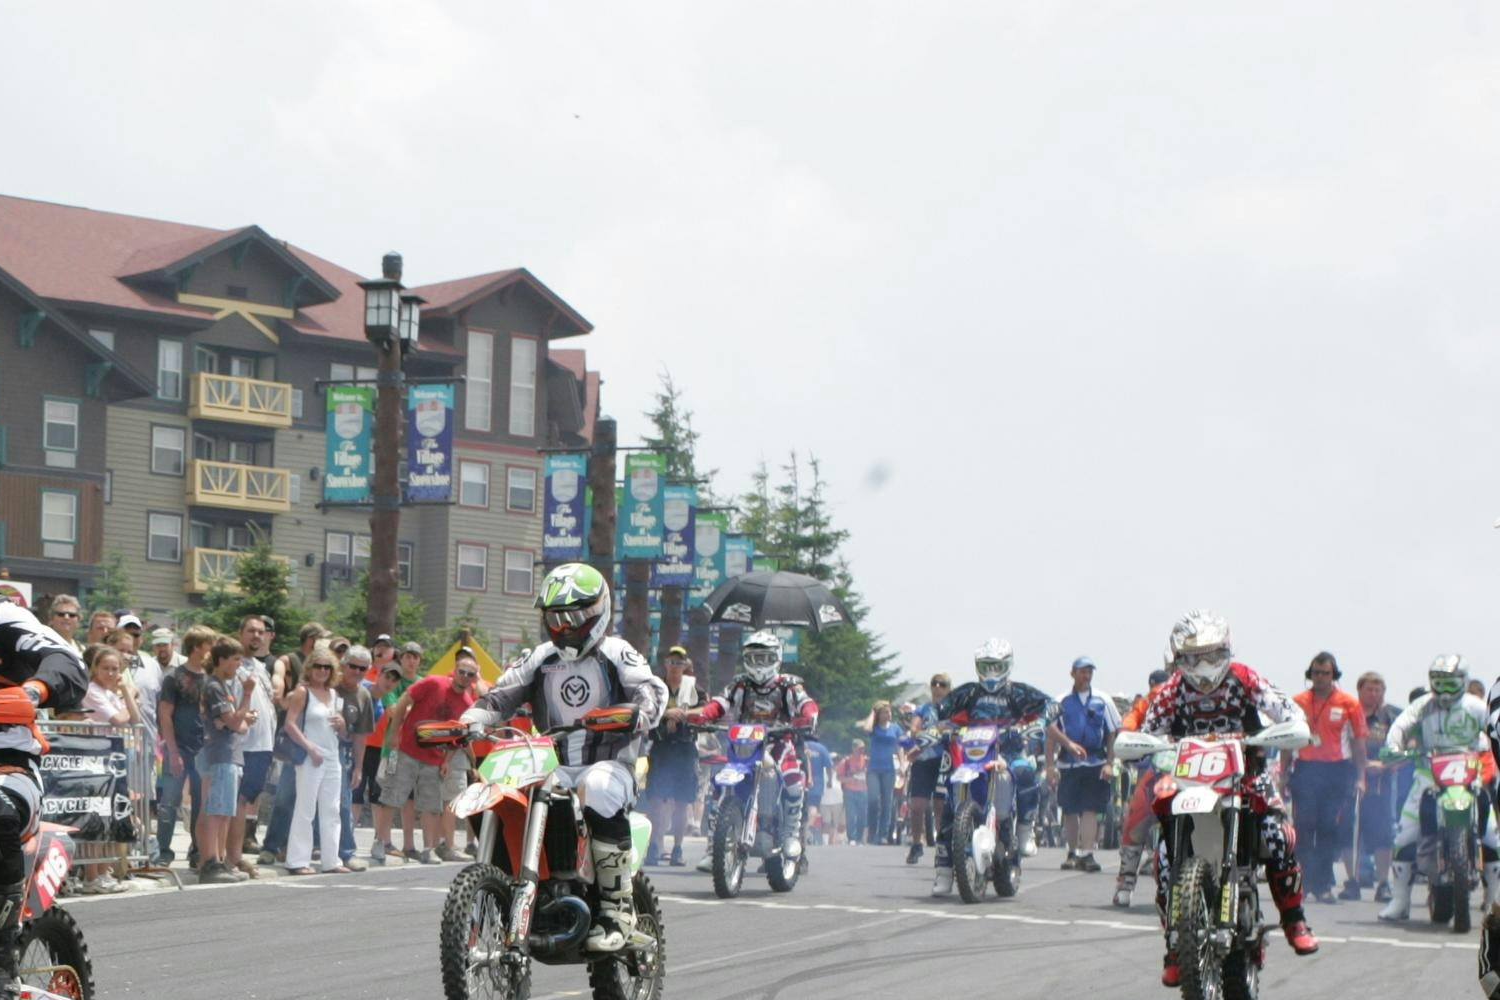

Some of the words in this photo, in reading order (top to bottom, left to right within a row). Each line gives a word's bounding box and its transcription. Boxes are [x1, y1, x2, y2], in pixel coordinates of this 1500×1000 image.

[334, 450, 362, 469] Village
[416, 449, 444, 468] Village
[326, 473, 367, 488] Snowshoe
[409, 471, 450, 486] Snowshoe
[551, 512, 576, 530] Village
[631, 512, 656, 529] Village
[1186, 751, 1227, 778] 16
[1441, 760, 1467, 783] 4
[37, 847, 68, 897] 116
